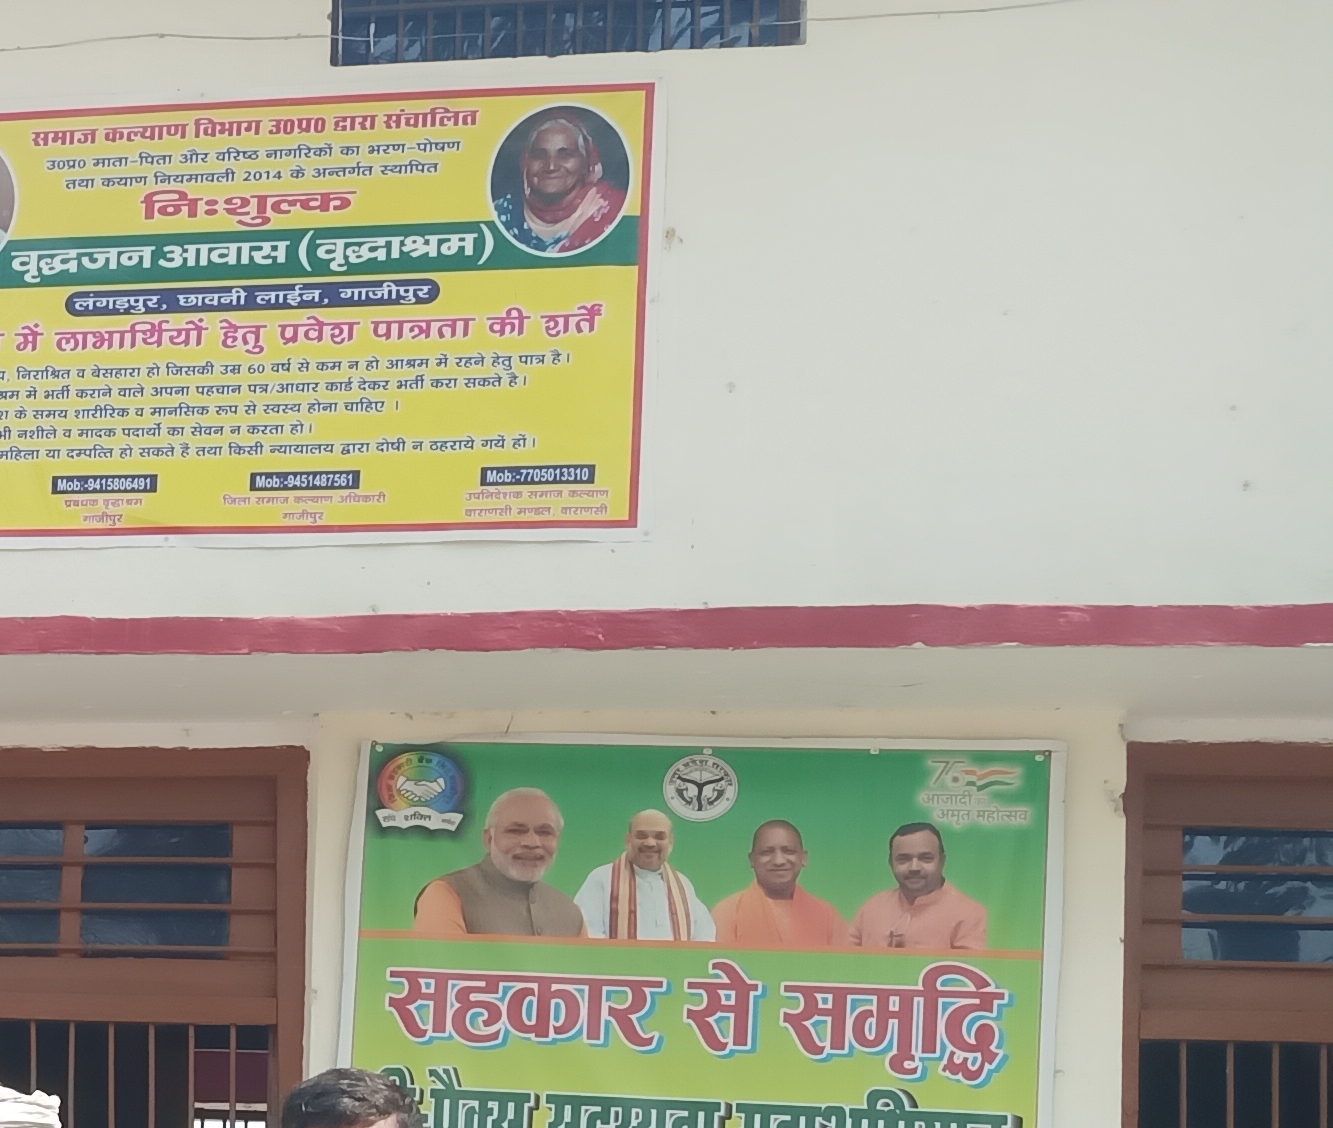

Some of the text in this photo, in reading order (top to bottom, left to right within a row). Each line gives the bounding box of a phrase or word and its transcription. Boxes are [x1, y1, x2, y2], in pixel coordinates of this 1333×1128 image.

[31, 106, 479, 146] समाज कल्याण विभाग उ0प्र0 द्वारा संचालित
[46, 137, 461, 170] उ0प्र0 माता-पिता और वरिष्ठ नागरिकों का भरण-पोषण
[64, 159, 439, 190] तथा कयाण नियमावली 2014 के अन्तर्गत स्थापित
[140, 190, 357, 227] निःशुल्क
[10, 224, 494, 283] वृद्धजन आवास (वृद्धाश्रम)
[71, 282, 433, 316] लंगड़पुर, छावनी लाईन, गाजीपुर
[14, 322, 44, 352] में
[53, 317, 209, 352] लाभार्थियों
[218, 318, 267, 352] हेतु
[277, 315, 360, 345] प्रवेश
[370, 317, 476, 341] पात्रता
[486, 306, 531, 337] की
[540, 303, 603, 337] शर्तें
[15, 364, 71, 380] निराश्रित
[75, 368, 86, 379] व
[90, 363, 141, 379] बेसहारा
[145, 362, 161, 378] हो
[165, 360, 214, 376] जिसकी
[219, 363, 242, 375] उम्र
[247, 363, 265, 374] 60
[270, 357, 291, 373] वर्ष
[296, 357, 310, 372] से
[315, 360, 342, 371] कम
[347, 360, 360, 371] न
[364, 355, 380, 371] हो
[385, 358, 430, 369] आश्रम
[434, 353, 449, 368] में
[454, 352, 486, 368] रहने
[490, 351, 513, 371] हेतु
[518, 354, 546, 365] पात्र
[25, 385, 37, 400] में
[43, 384, 71, 400] भर्ती
[75, 383, 113, 399] कराने
[117, 382, 145, 398] वाले
[150, 385, 190, 397] अपना
[195, 384, 242, 397] पहचान
[324, 376, 353, 392] कार्ड
[357, 376, 390, 391] देकर
[396, 373, 425, 389] भर्ती
[429, 377, 458, 389] करा
[462, 372, 503, 388] सकते
[13, 405, 27, 419] के
[31, 409, 68, 420] समय
[73, 403, 130, 419] शारीरिक
[134, 407, 144, 417] व
[149, 401, 210, 417] मानसिक
[214, 404, 239, 415] रूप
[243, 399, 257, 415] से
[306, 398, 338, 414] होना
[342, 396, 385, 413] चाहिए
[57, 477, 151, 491] Mob:-9415806491
[255, 474, 353, 489] Mob:-9451487561
[486, 467, 589, 483] Mob:-7705013310
[937, 806, 1029, 825] अमृत महोत्सव
[387, 967, 671, 1052] सहकार
[684, 959, 762, 1056] से
